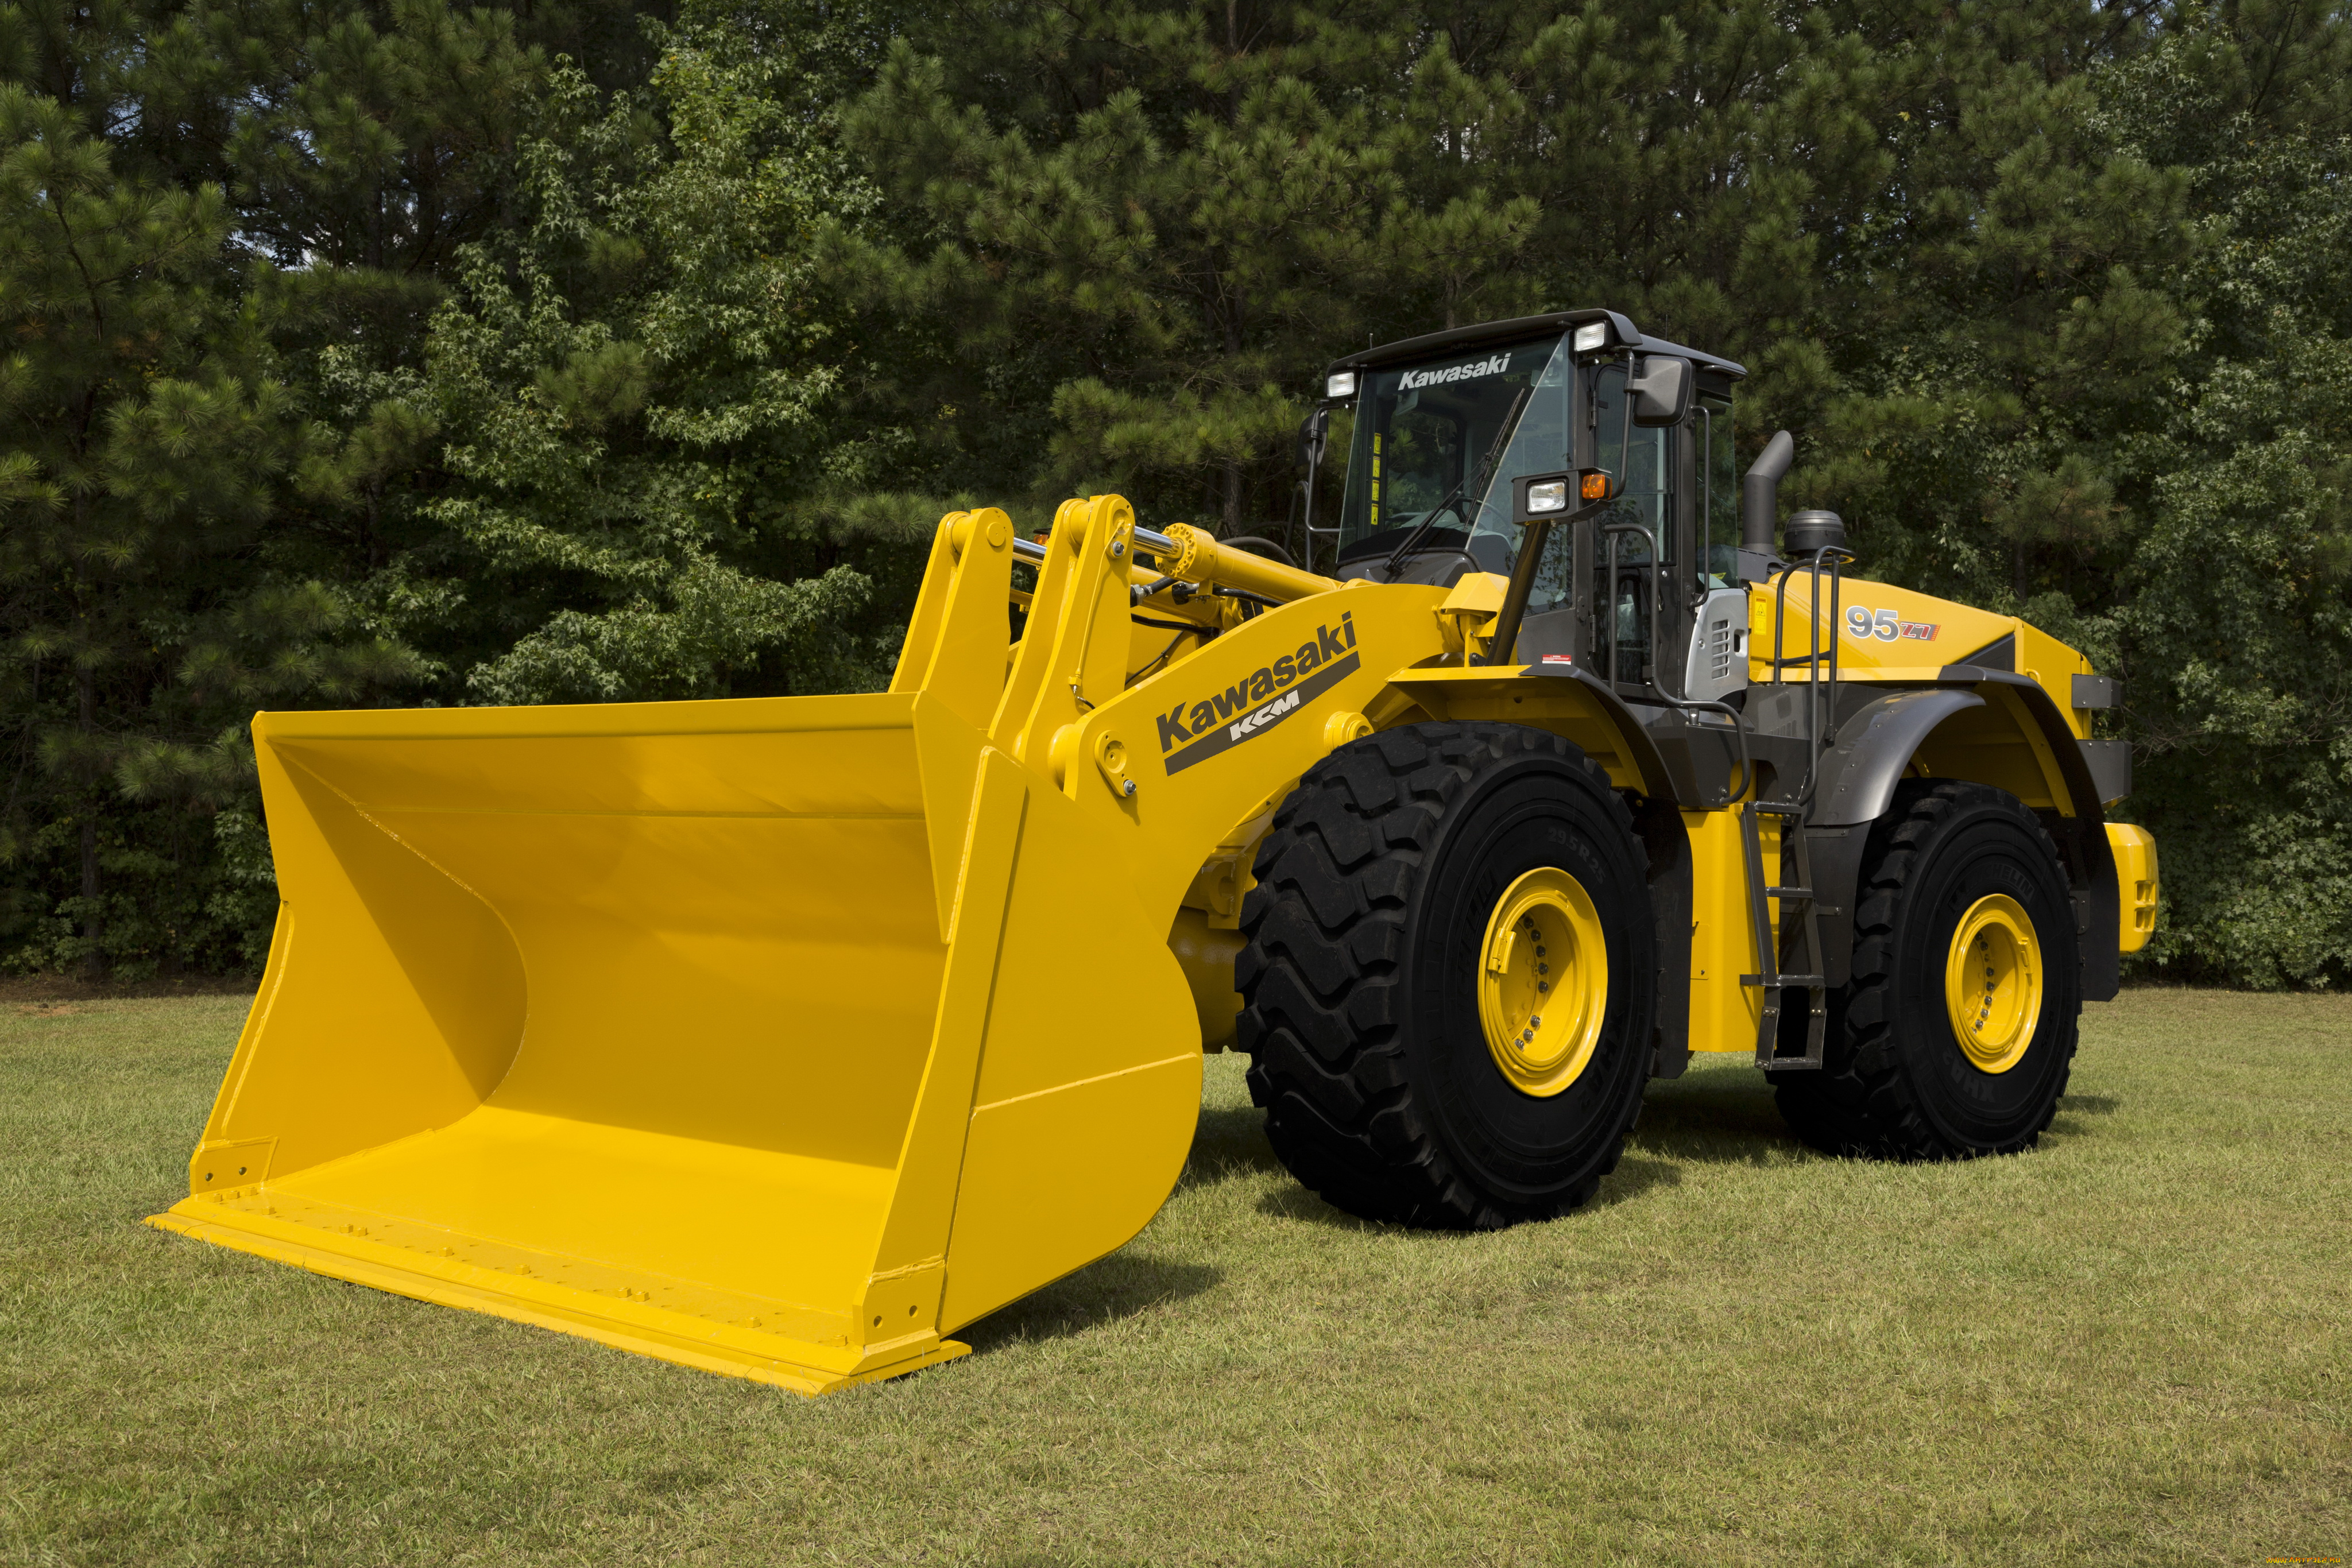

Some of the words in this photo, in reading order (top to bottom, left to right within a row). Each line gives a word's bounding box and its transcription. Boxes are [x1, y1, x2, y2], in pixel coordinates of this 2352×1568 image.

[1398, 353, 1511, 390] Kawasaki
[1156, 610, 1357, 753] Kawasaki
[1229, 689, 1300, 741] KCM
[1967, 863, 2033, 897] MICHELIN
